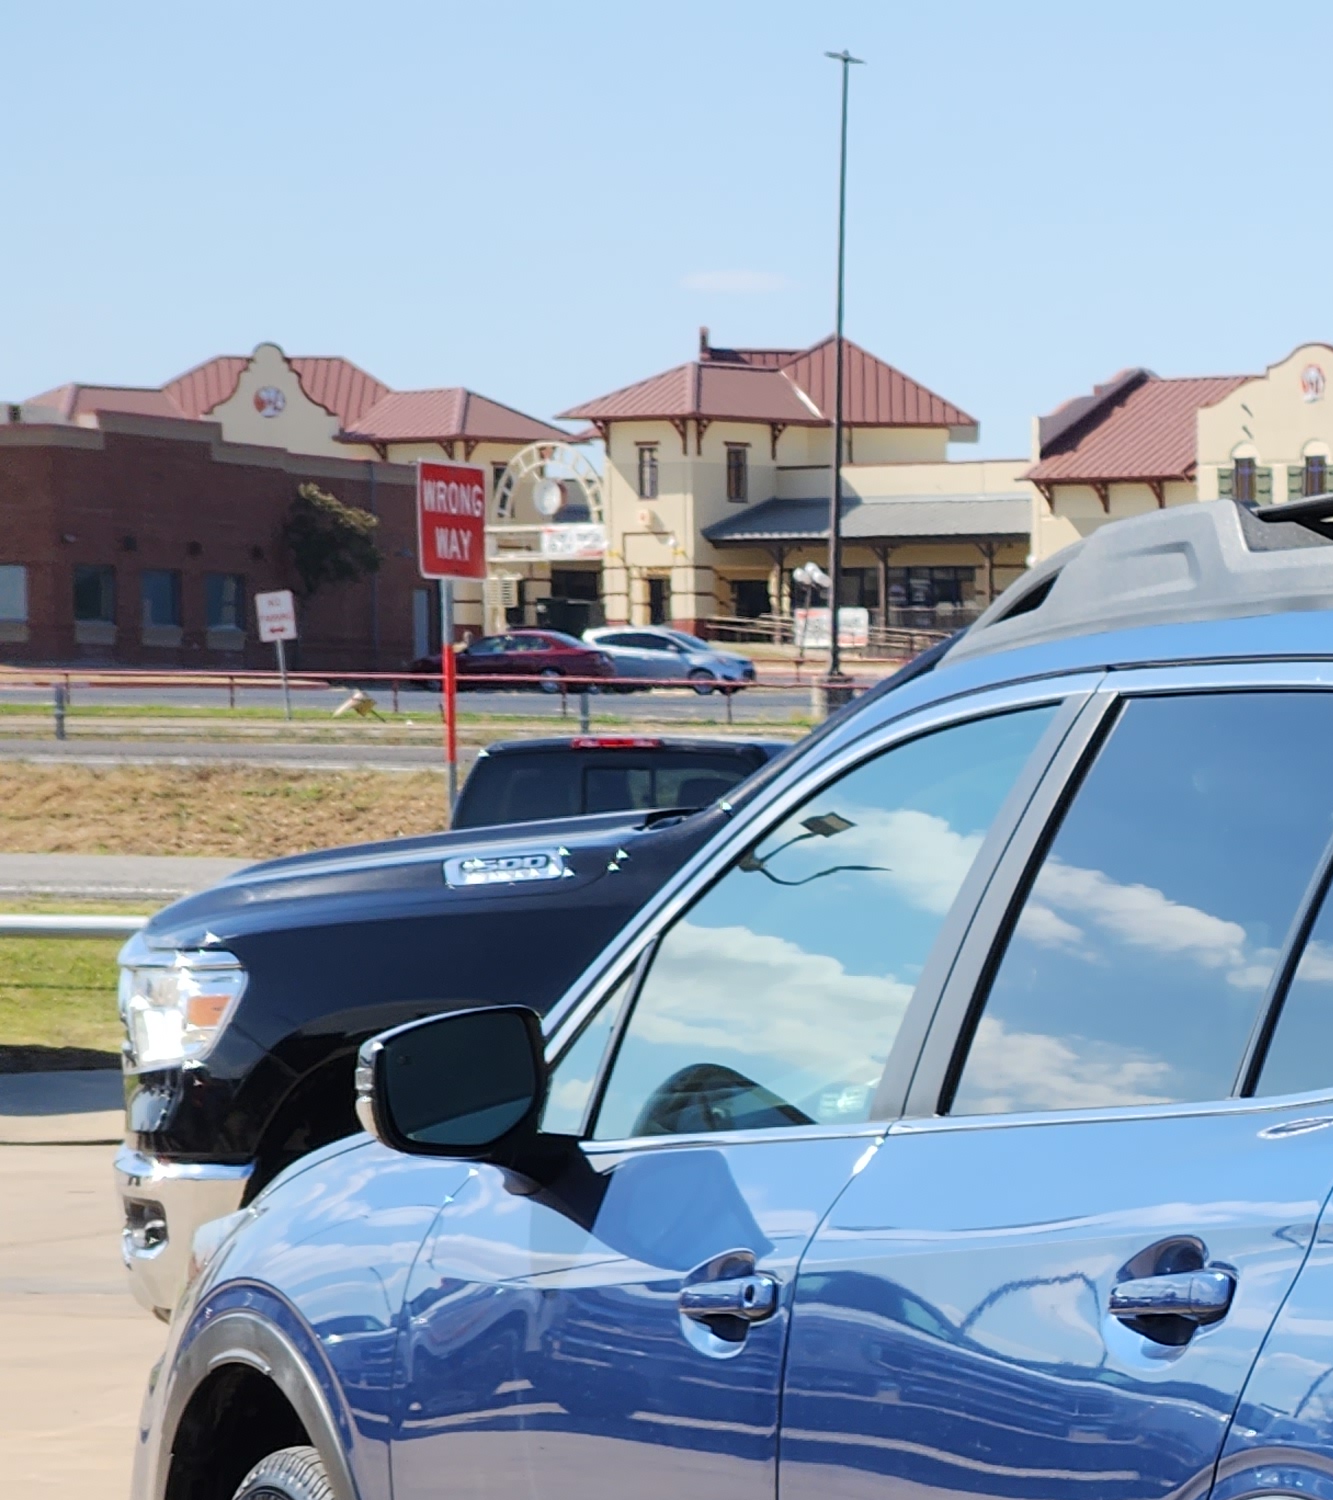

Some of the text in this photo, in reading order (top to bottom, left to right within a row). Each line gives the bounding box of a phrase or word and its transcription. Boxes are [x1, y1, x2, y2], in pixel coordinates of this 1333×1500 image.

[422, 479, 483, 517] WRONG
[434, 526, 472, 561] WAY
[462, 853, 549, 873] 500
